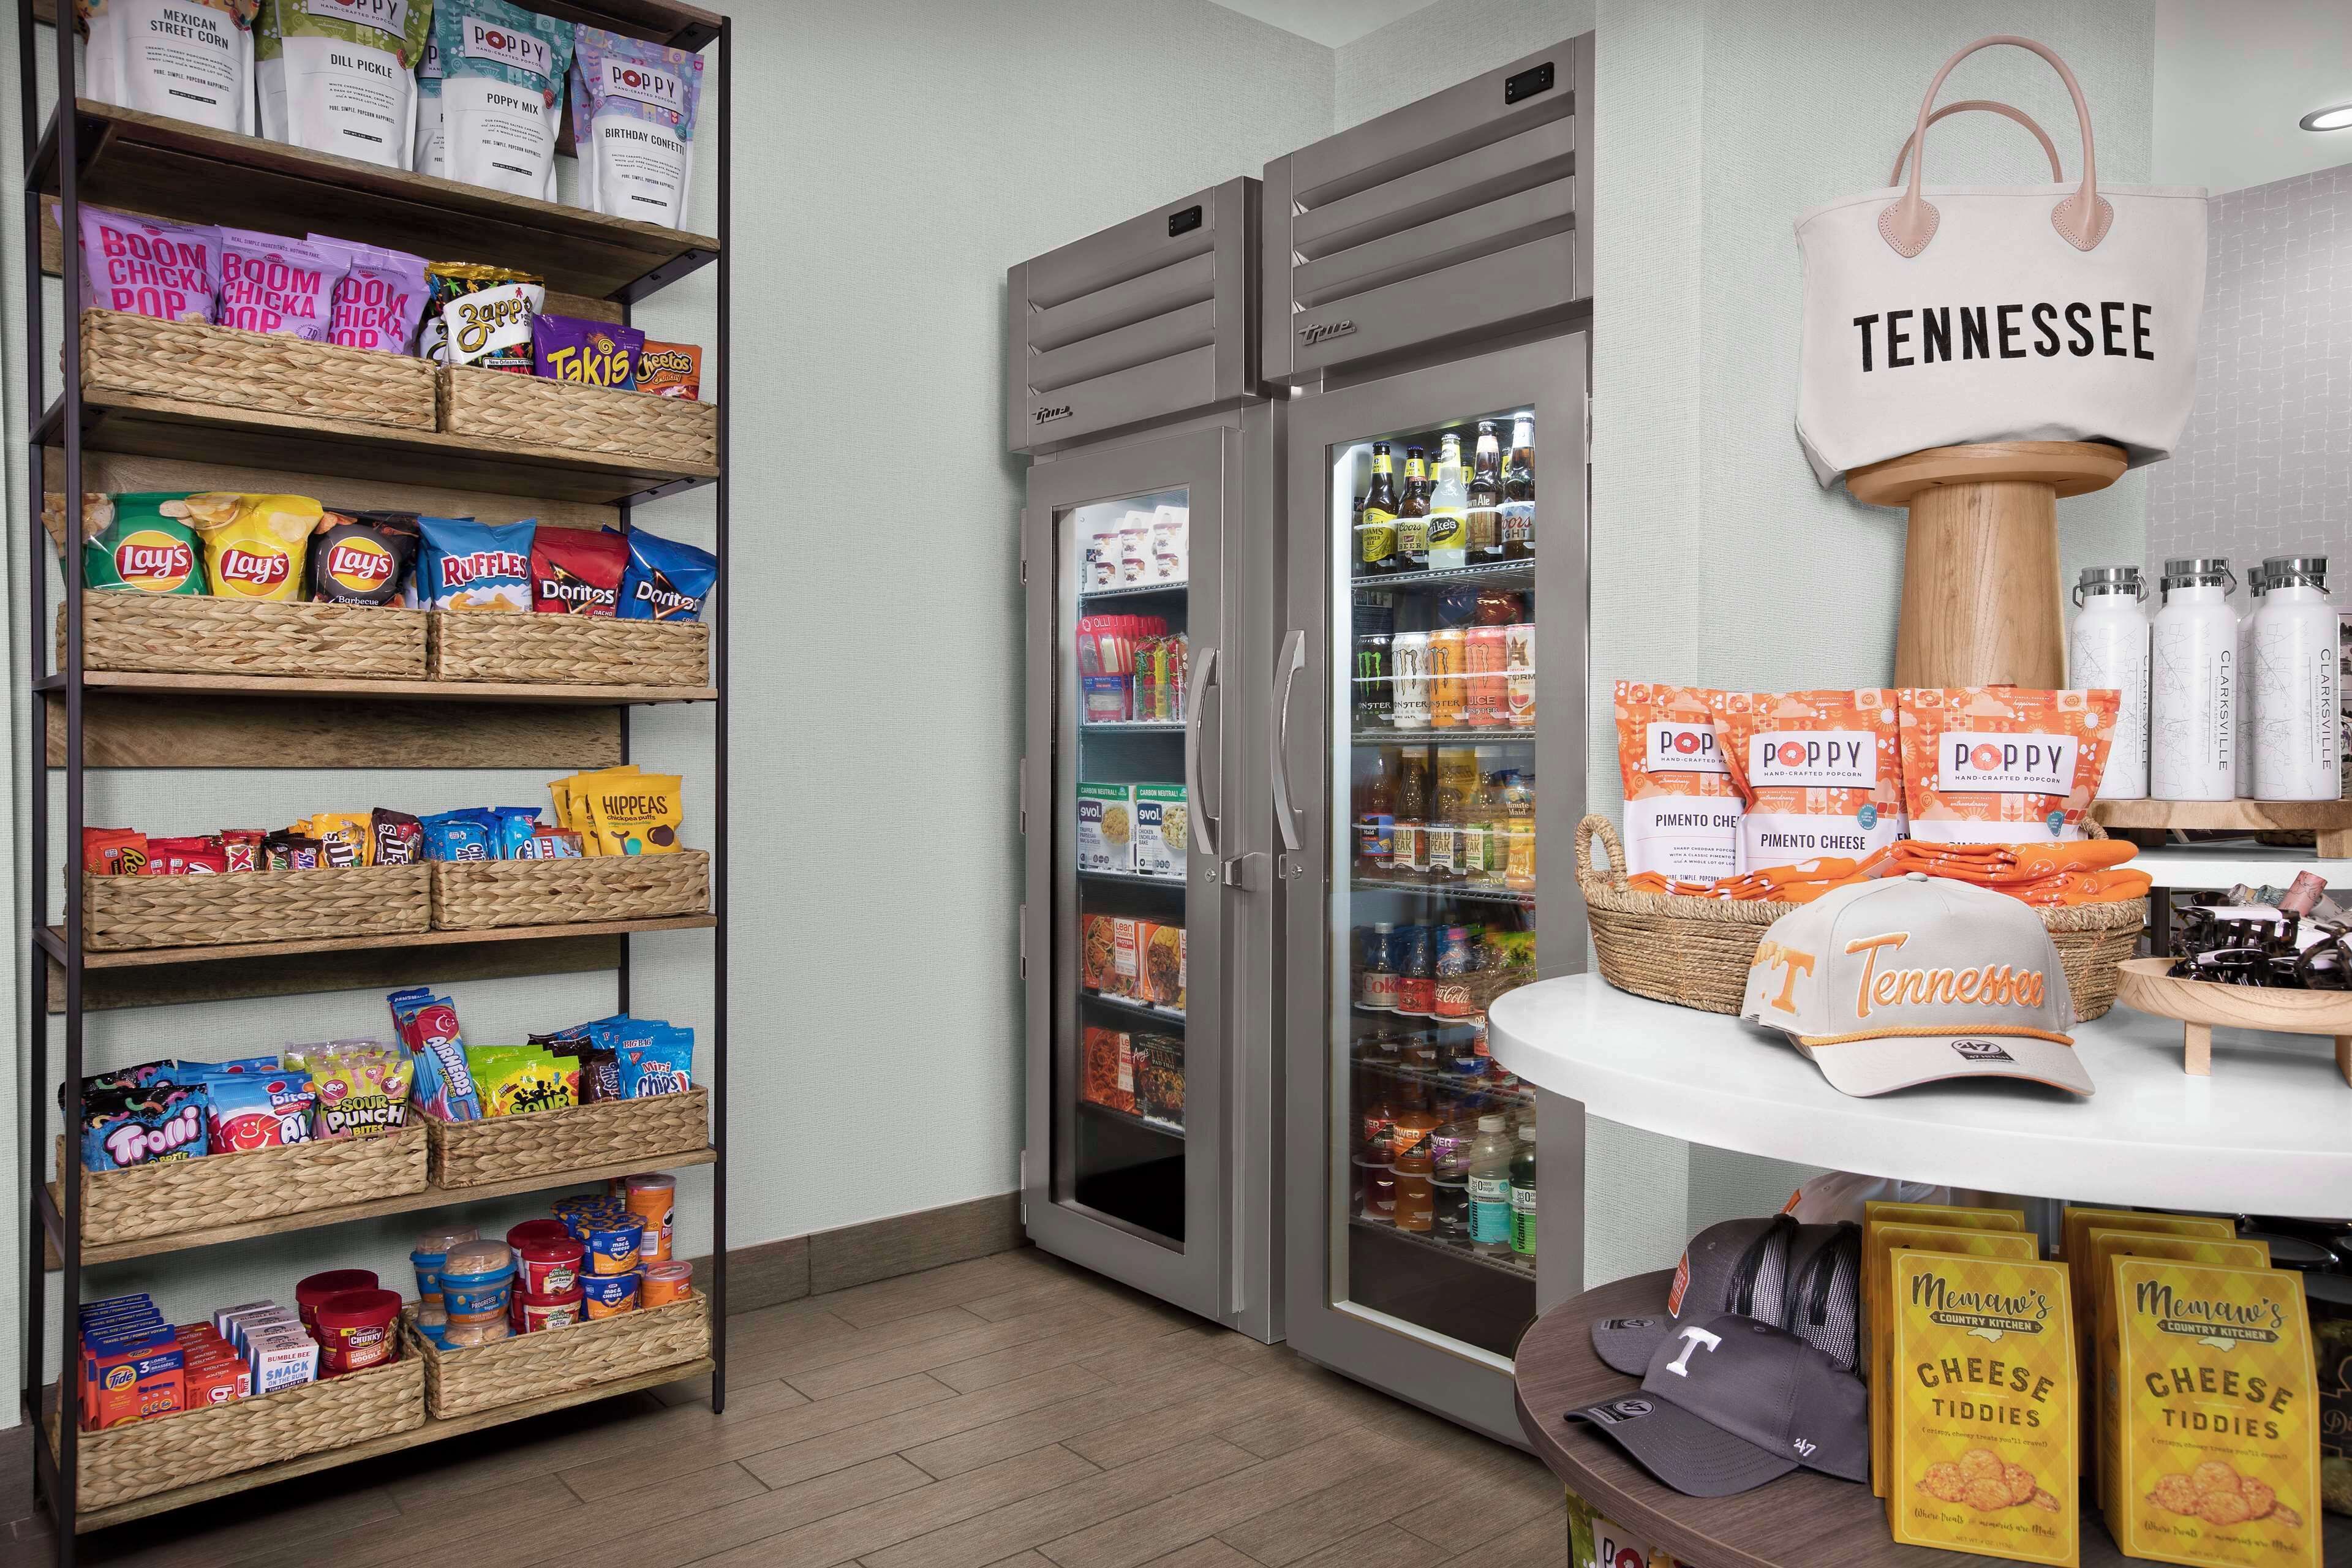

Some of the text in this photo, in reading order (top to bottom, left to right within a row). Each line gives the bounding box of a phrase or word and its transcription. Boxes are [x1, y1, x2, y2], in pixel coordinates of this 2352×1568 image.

[164, 9, 216, 32] MEXICAN
[320, 3, 398, 28] HAND-CRAFTED POPCORN
[151, 20, 228, 50] STREET CORN
[475, 26, 543, 62] POPPY
[331, 54, 393, 78] DILL PICKLE
[612, 66, 674, 98] POPPY
[487, 93, 538, 115] POPPY MIX
[614, 86, 676, 105] HAND-CRAFTED POPCORN
[605, 128, 684, 156] BIRTHDAY CONFETTI
[100, 225, 207, 274] BOOM
[108, 258, 213, 299] CHICKA
[223, 253, 322, 295] BOOM
[222, 281, 315, 319] CHICKA
[1853, 301, 2154, 372] TENNESSEE
[653, 373, 682, 383] Crunchy
[1477, 494, 1490, 506] Ale
[1399, 522, 1422, 532] Coors
[123, 545, 188, 579] Lay's
[224, 550, 286, 584] Lay's
[332, 547, 390, 579] Lay's
[441, 552, 528, 587] RUFFLES
[338, 595, 379, 606] Barbecue
[542, 579, 615, 605] Doritos
[635, 581, 700, 611] Doritos
[1093, 616, 1110, 627] OLLI
[2219, 650, 2231, 771] CLARKSVILLE
[2320, 648, 2331, 771] CLARKSVILLE
[1763, 740, 1863, 768] POPPY
[1955, 743, 2062, 775] POPPY
[602, 795, 668, 815] HIPPEAS
[1080, 805, 1101, 818] evol.
[1139, 809, 1161, 821] evol.
[1656, 813, 1740, 829] PIMENTO CHE
[1395, 840, 1411, 851] PEAK
[1431, 841, 1450, 851] PEAK
[1760, 833, 1866, 851] PIMENTO CHEESE
[1115, 922, 1133, 932] Lean
[1844, 930, 2045, 1020] Tennessee
[638, 1037, 652, 1047] BAG
[427, 1036, 471, 1096] AIRHEADS
[1132, 1047, 1149, 1064] Amy's
[642, 1061, 671, 1073] Mini
[437, 1068, 456, 1098] XTREMES
[638, 1074, 679, 1098] Chips
[271, 1092, 315, 1106] bites
[341, 1095, 388, 1112] SOUR
[328, 1106, 406, 1133] PUNCH
[353, 1125, 383, 1135] BITES
[107, 1106, 198, 1163] Trolli
[159, 1152, 189, 1162] BRITE
[471, 1296, 497, 1309] PROGRESSO
[1911, 1272, 2054, 1319] Memaw's
[2136, 1279, 2288, 1328] Memaw's
[93, 1327, 110, 1336] TRAVEL
[1939, 1313, 2033, 1332] COUNTRY KITCHEN
[2168, 1321, 2267, 1341] COUNTRY KITCHEN
[103, 1335, 120, 1344] TRAVEL
[133, 1330, 151, 1339] FORMAT
[351, 1333, 382, 1344] CHUNKY
[268, 1353, 295, 1362] BUMBLE
[352, 1351, 382, 1363] NOODLE
[1666, 1325, 1723, 1378] T
[107, 1371, 134, 1387] Tide
[140, 1362, 149, 1374] 3
[266, 1361, 309, 1381] SNACK
[278, 1376, 290, 1384] THE
[291, 1372, 307, 1382] RUN!
[281, 1381, 295, 1390] SALAD
[1916, 1357, 2055, 1403] CHEESE
[2145, 1366, 2294, 1415] CHEESE
[1932, 1398, 2041, 1428] TIDDIES
[2162, 1408, 2280, 1440] TIDDIES
[1794, 1437, 1817, 1457] '47
[1926, 1427, 1951, 1438] crispy,
[1952, 1431, 1975, 1440] cheesy
[1999, 1437, 2021, 1446] you'll
[1914, 1508, 1940, 1521] Where
[1979, 1520, 2013, 1532] memories
[2015, 1524, 2029, 1532] are
[2032, 1523, 2056, 1537] Made
